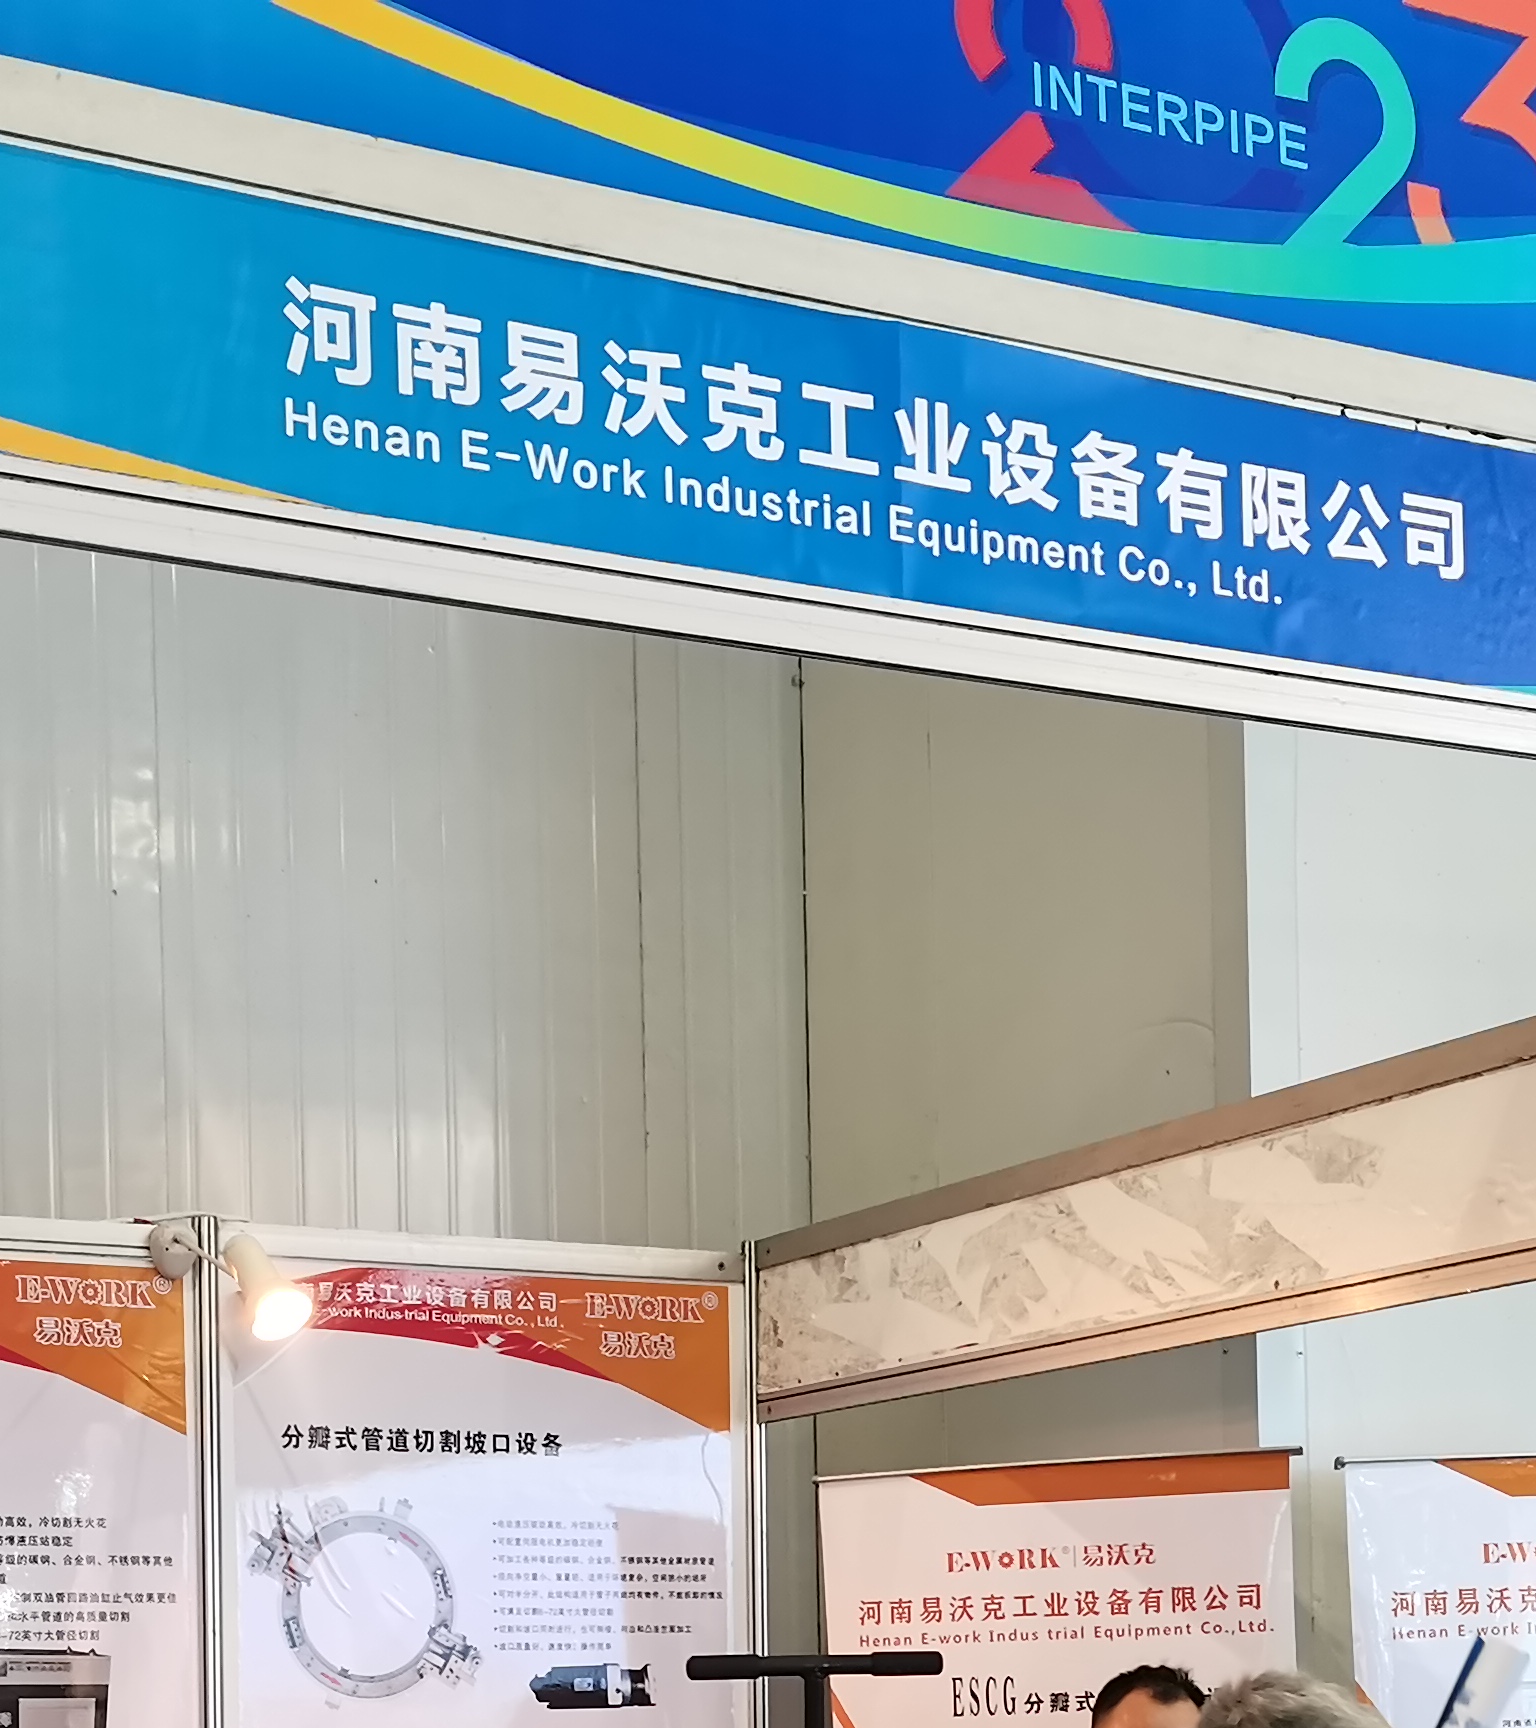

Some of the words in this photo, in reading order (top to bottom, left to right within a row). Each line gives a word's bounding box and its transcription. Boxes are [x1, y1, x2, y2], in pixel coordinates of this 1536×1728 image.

[1032, 61, 1309, 170] INTERPIPE
[282, 274, 1467, 581] 河南易沃克工业设备有限公司
[282, 398, 441, 466] Henan
[461, 426, 647, 500] E-Work
[664, 473, 872, 538] Industrial
[888, 505, 1106, 580] Equipment
[1119, 545, 1197, 600] Co.,
[1211, 560, 1286, 607] Ltd.
[34, 1317, 123, 1348] 易沃克
[432, 1310, 503, 1327] Equipment
[600, 1331, 676, 1359] 易沃克
[281, 1423, 564, 1457] 分瓣式管道切割坡口设备
[1081, 1542, 1157, 1567] 易沃克
[858, 1583, 1263, 1626] 河南易沃克工业设备有限公司
[859, 1633, 912, 1648] Henan
[921, 1630, 981, 1645] E-work
[989, 1628, 1039, 1643] Indus
[1047, 1625, 1085, 1640] trial
[1094, 1622, 1192, 1642] Equipment
[1392, 1626, 1449, 1641] Henan
[1457, 1623, 1519, 1638] E-work
[952, 1675, 1017, 1718] ESCG
